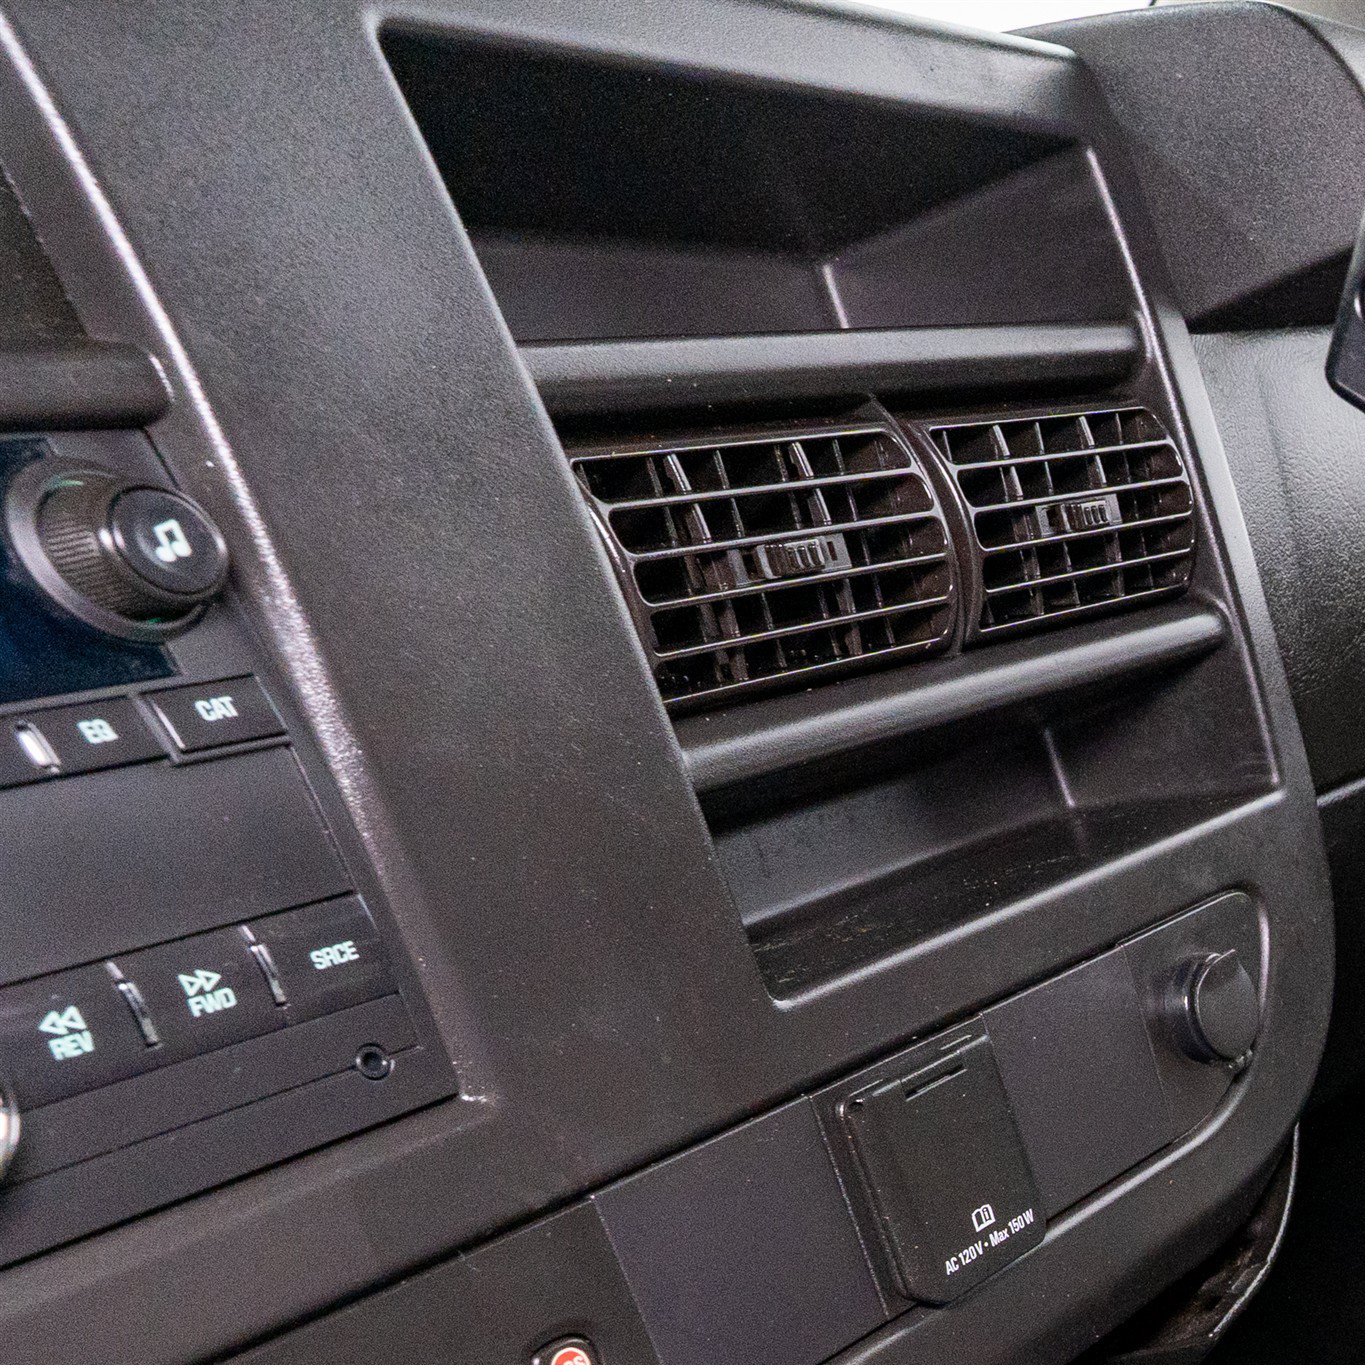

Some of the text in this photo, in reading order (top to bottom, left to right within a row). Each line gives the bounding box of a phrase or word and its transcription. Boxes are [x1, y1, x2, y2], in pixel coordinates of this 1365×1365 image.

[194, 695, 239, 721] CAT
[309, 940, 360, 970] SRCE
[186, 987, 238, 1017] FWD
[49, 1030, 95, 1060] REV
[945, 1257, 959, 1275] AC
[989, 1228, 1010, 1247] Max
